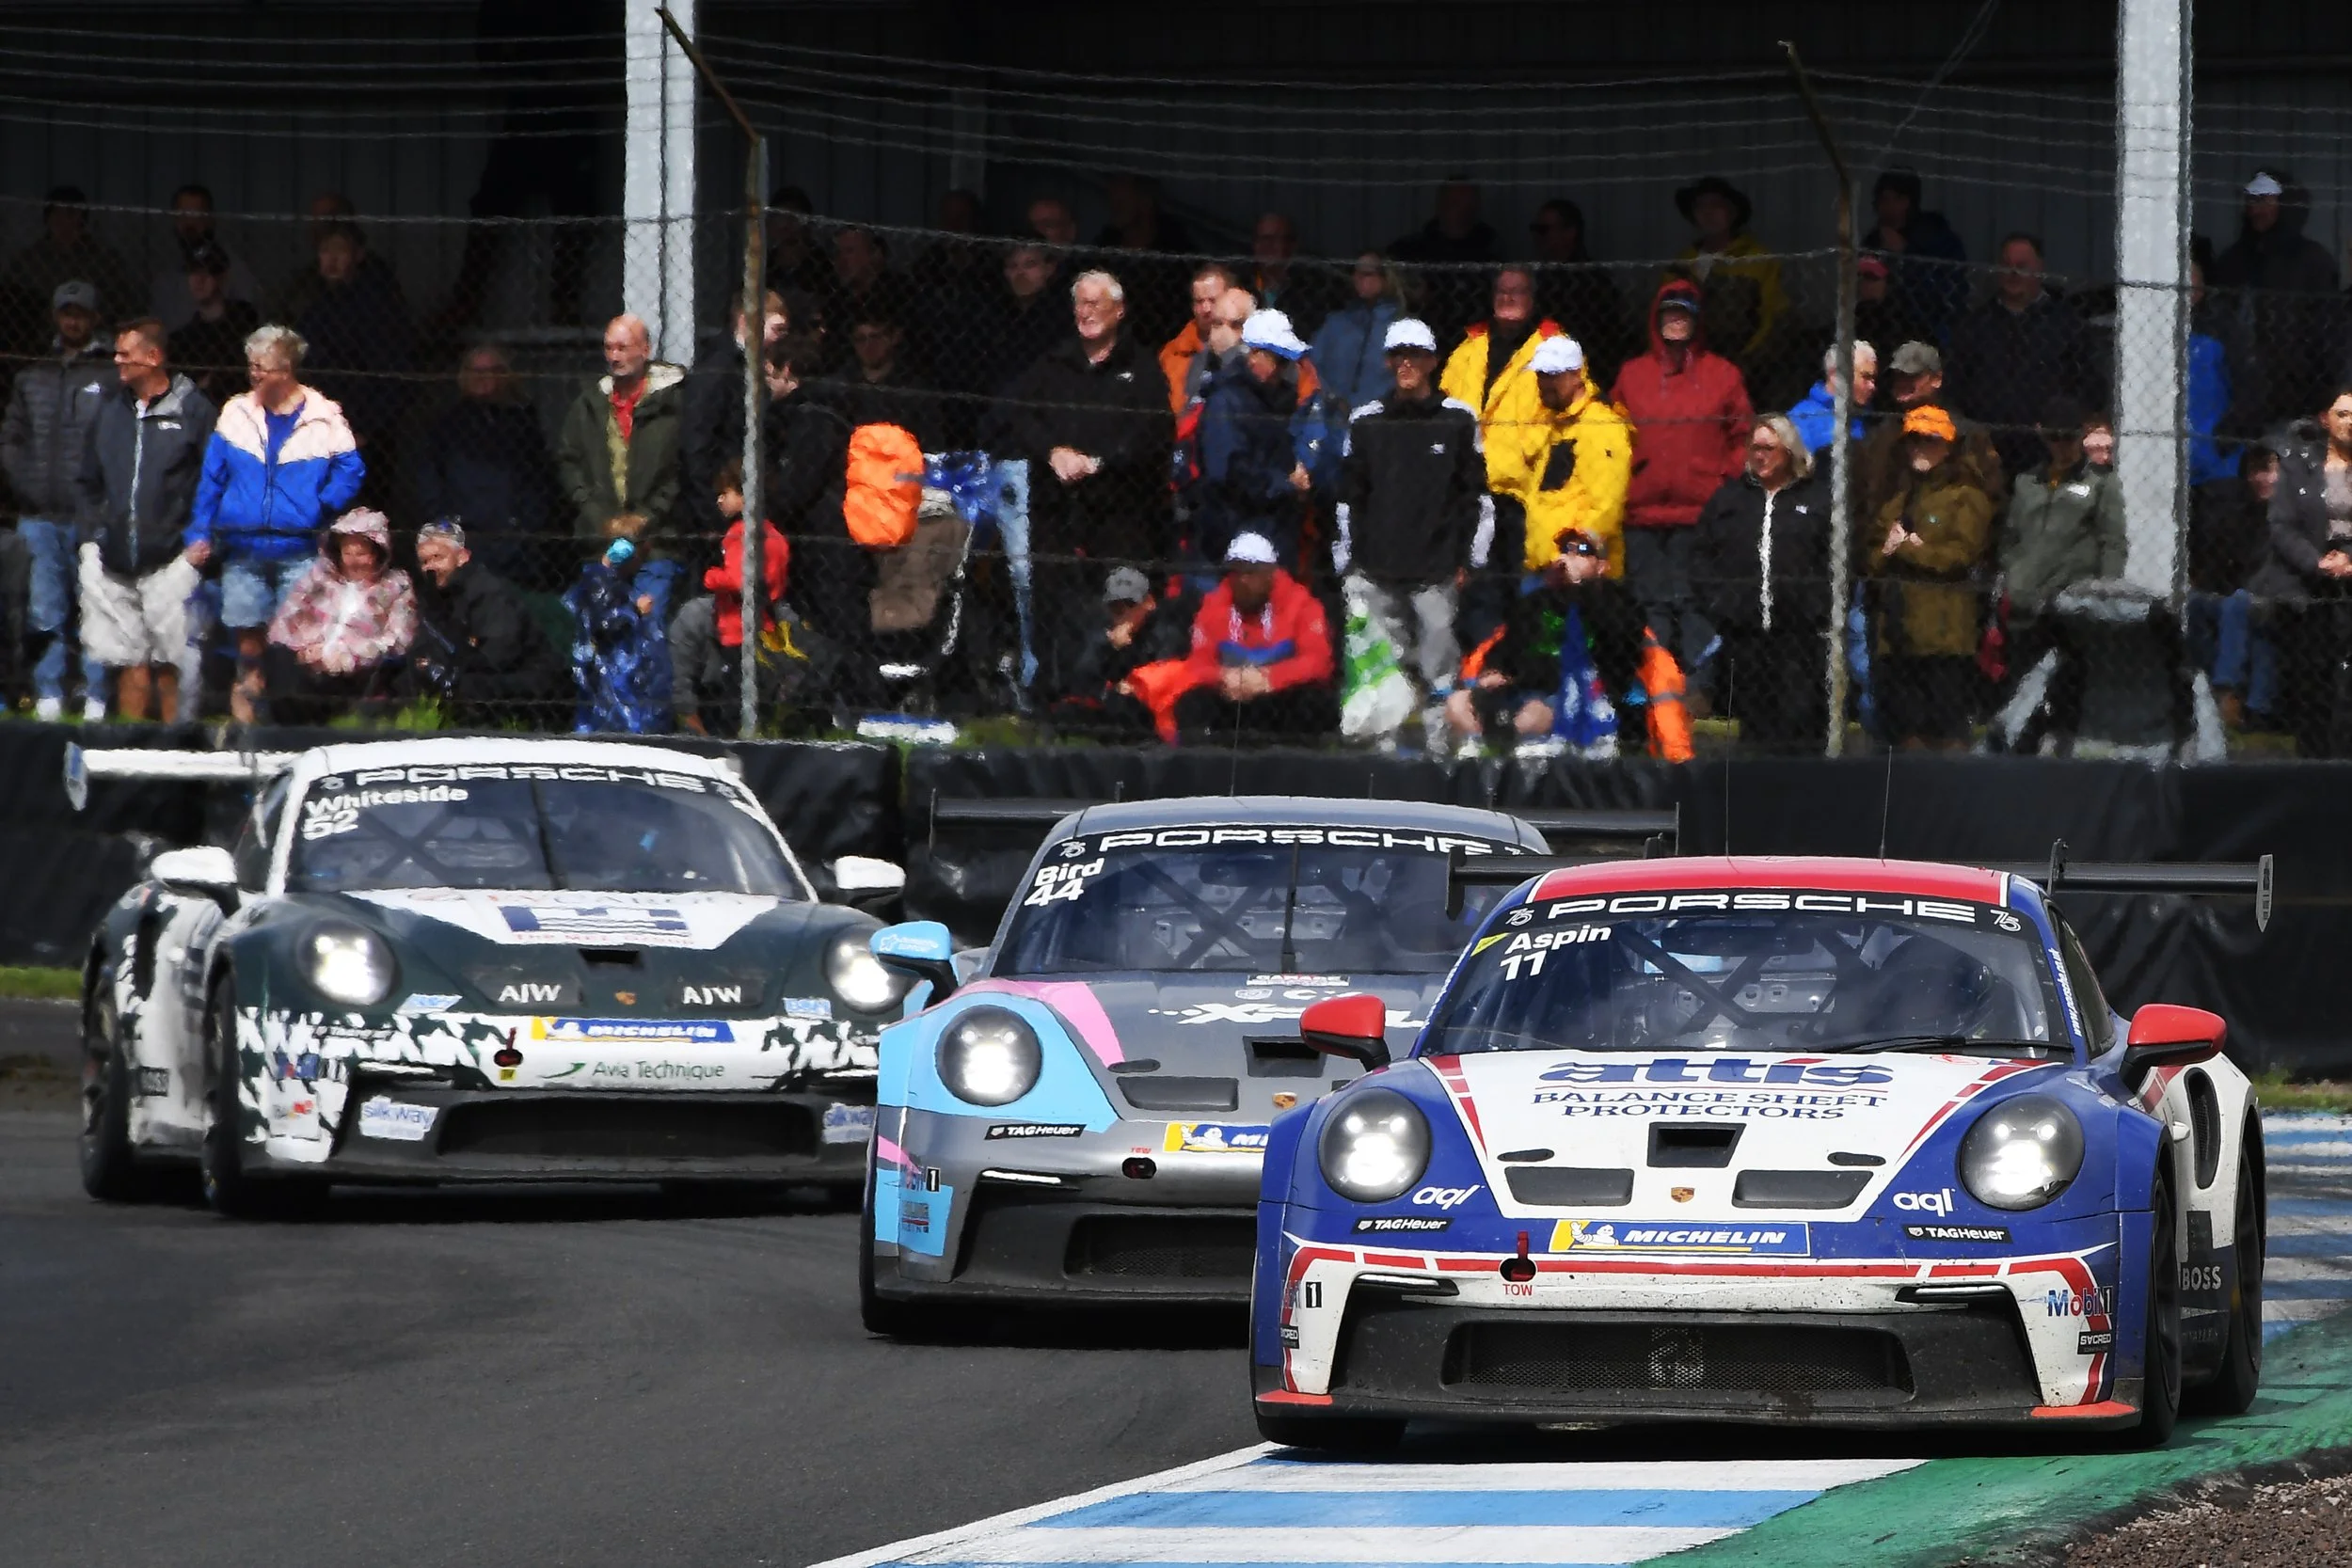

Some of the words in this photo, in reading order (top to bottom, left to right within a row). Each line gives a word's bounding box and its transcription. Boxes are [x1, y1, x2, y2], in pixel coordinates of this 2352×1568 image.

[356, 766, 706, 793] PORSCHE
[305, 784, 469, 816] Whiteside
[302, 809, 359, 841] 52
[1099, 829, 1493, 856] PORSCHE
[1034, 857, 1105, 887] Bird
[1024, 878, 1084, 907] 44
[1548, 893, 1976, 924] PORSCHE
[1990, 909, 2022, 932] 75
[1504, 924, 1612, 956] Aspin
[1500, 950, 1547, 981] 11
[587, 1024, 717, 1037] MICHELIN
[592, 1060, 630, 1078] Avia
[635, 1060, 725, 1082] Technique
[1531, 1091, 1739, 1105] BALANCE
[1745, 1092, 1888, 1108] SHEET
[1561, 1103, 1845, 1120] PROTECTORS
[1412, 1184, 1481, 1211] aql
[1893, 1187, 1954, 1217] aql
[1623, 1228, 1787, 1244] MICHELIN
[1502, 1284, 1533, 1296] TOW
[2182, 1265, 2222, 1291] BOSS
